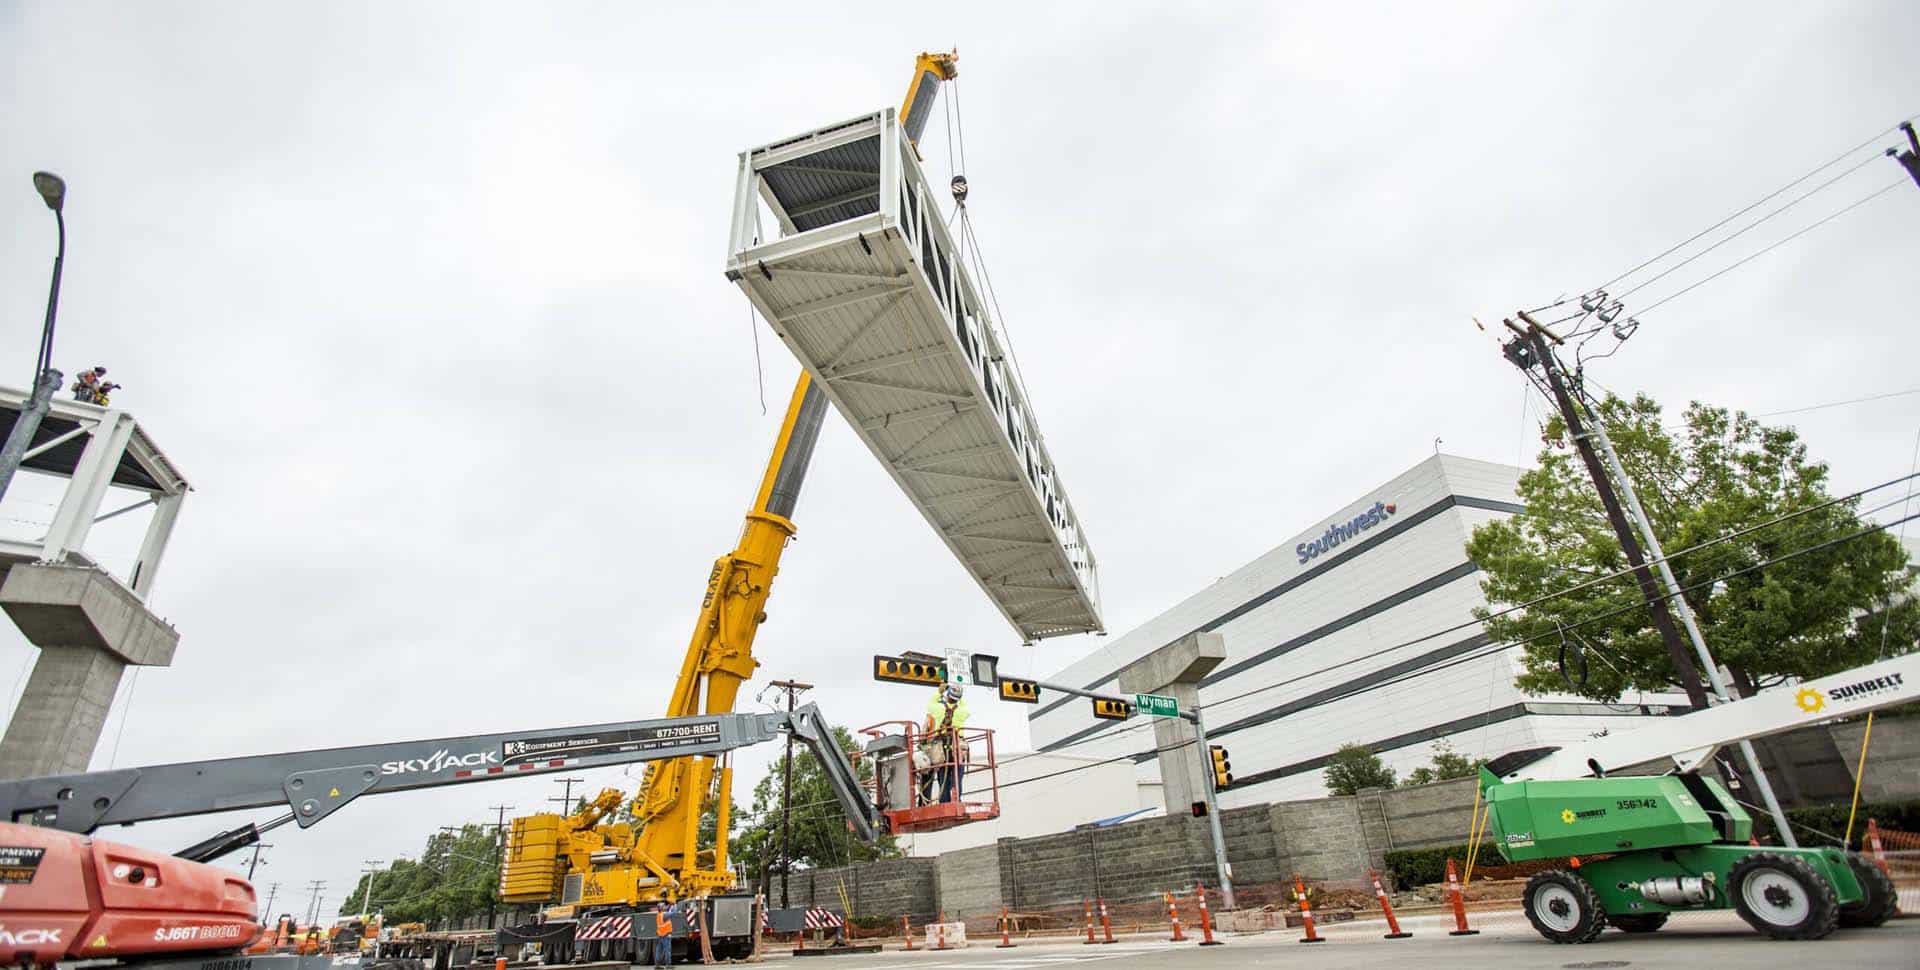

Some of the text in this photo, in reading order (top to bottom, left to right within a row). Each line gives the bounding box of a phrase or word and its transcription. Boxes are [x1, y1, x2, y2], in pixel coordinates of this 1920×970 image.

[1296, 502, 1388, 564] Southwest
[1829, 673, 1903, 700] SUNBELT
[1139, 695, 1175, 710] Wyman
[382, 749, 499, 774] SKYJACK
[154, 925, 240, 941] SJ66T BOOM
